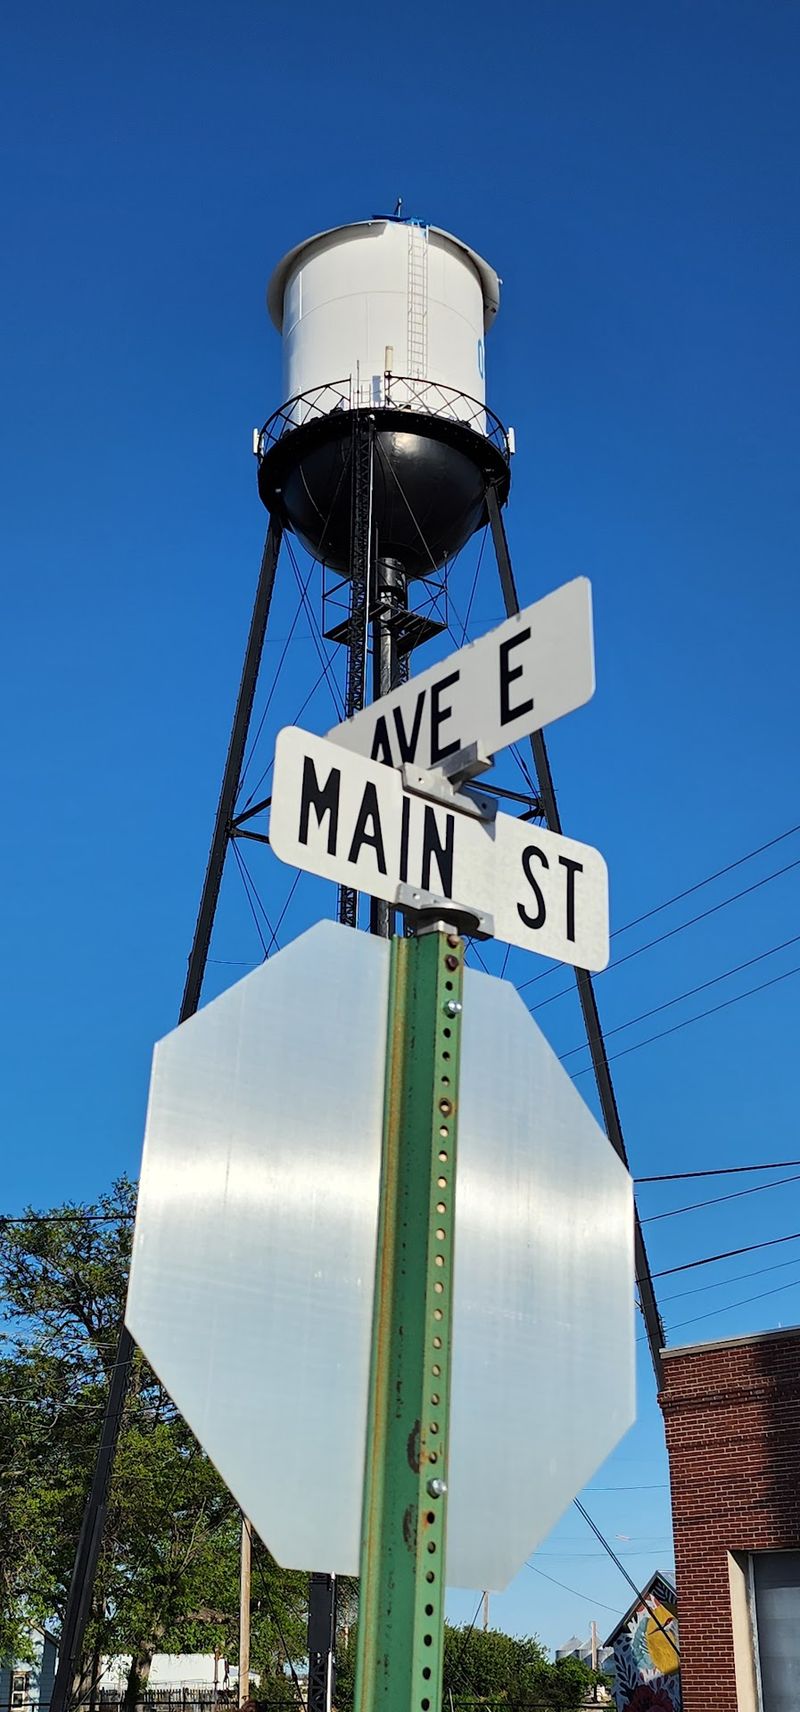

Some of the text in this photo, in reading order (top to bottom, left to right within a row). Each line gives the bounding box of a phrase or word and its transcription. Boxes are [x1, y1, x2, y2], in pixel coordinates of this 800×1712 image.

[370, 626, 534, 768] AVE E
[298, 755, 584, 943] MAIN ST
